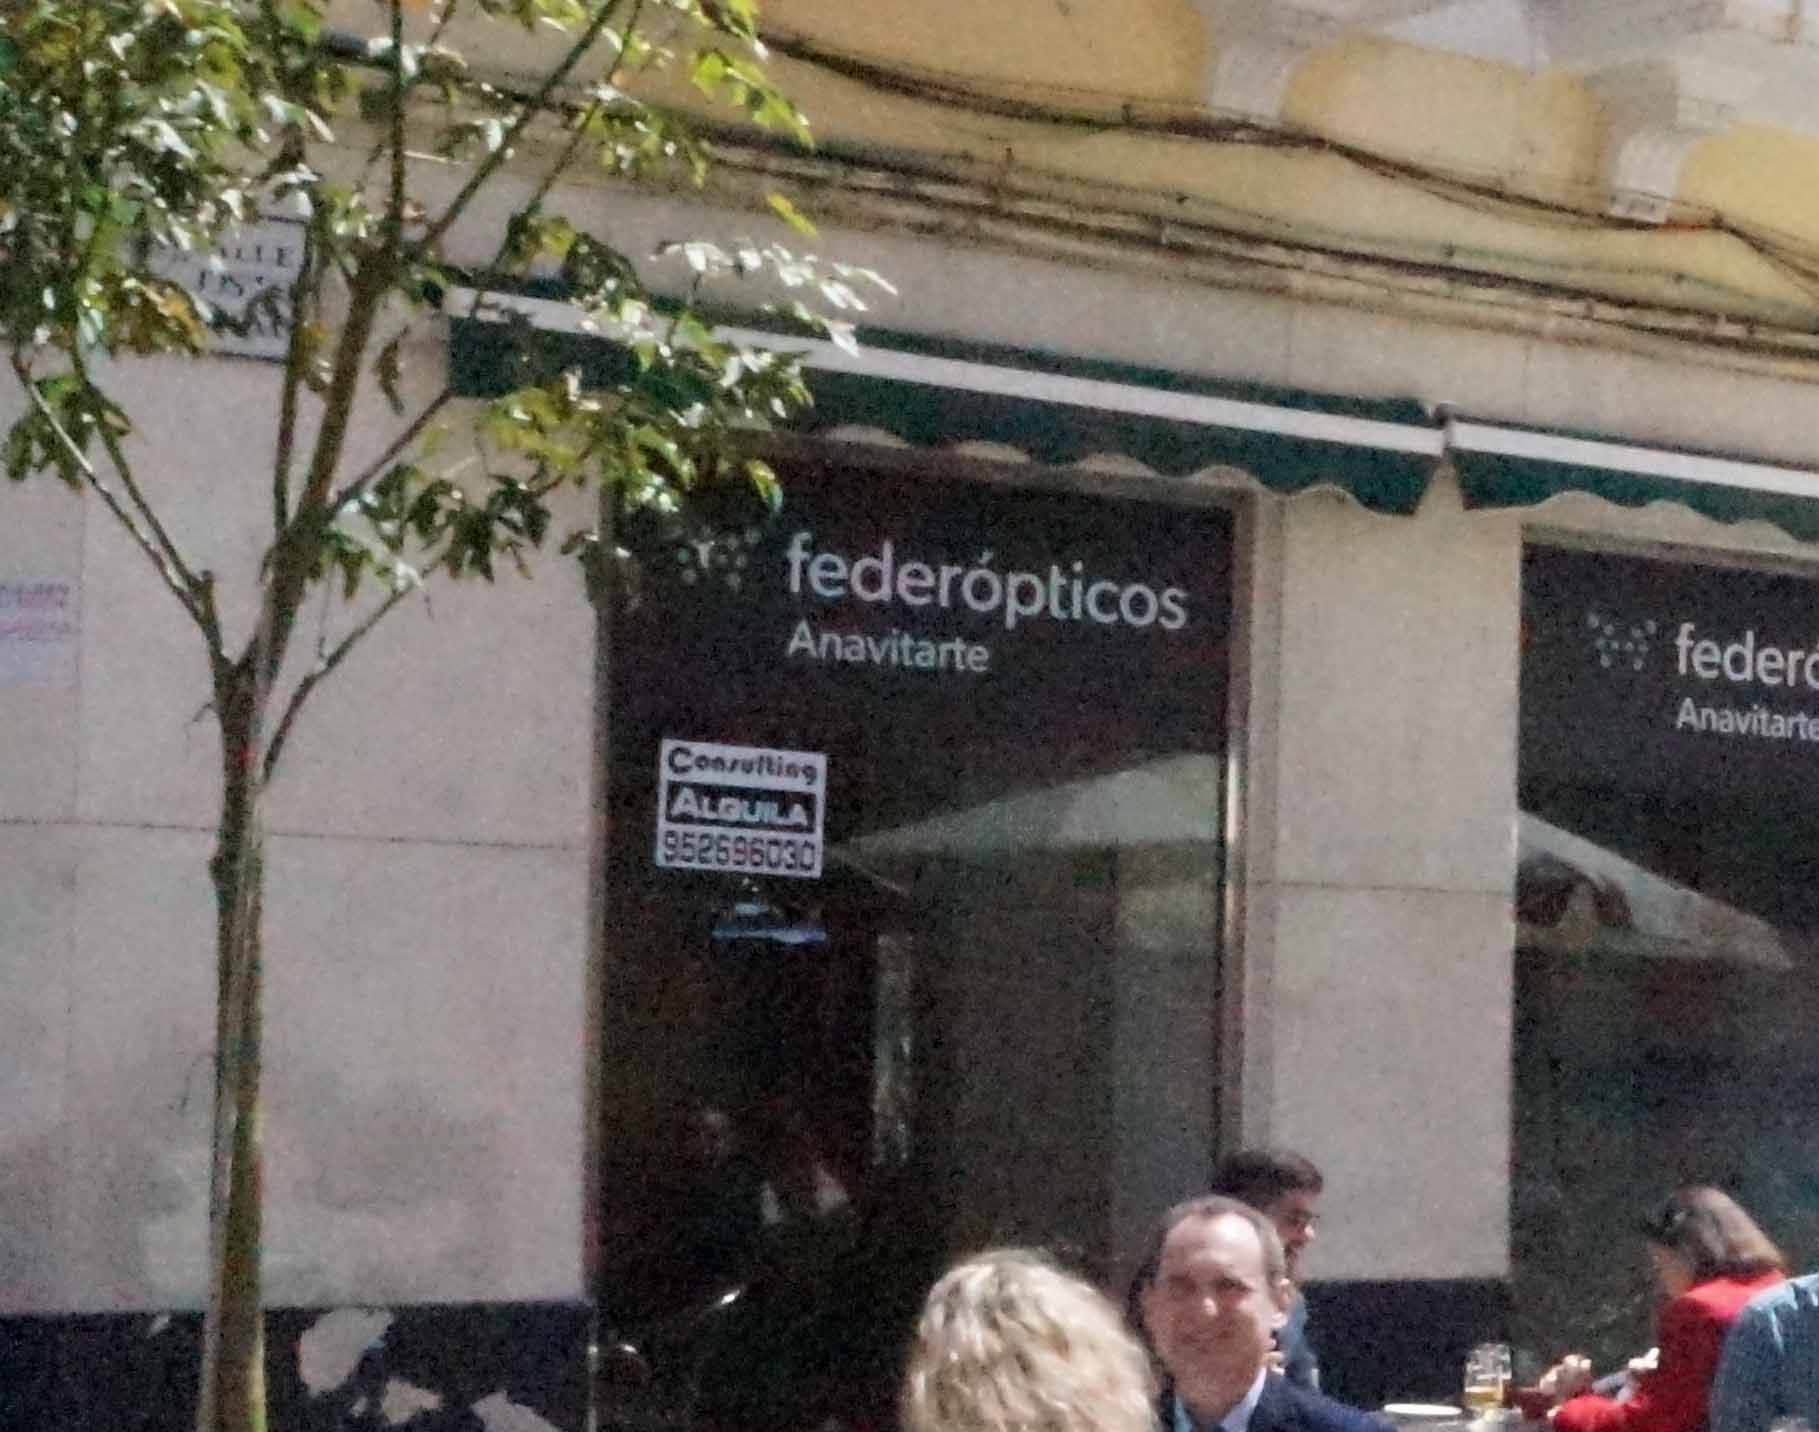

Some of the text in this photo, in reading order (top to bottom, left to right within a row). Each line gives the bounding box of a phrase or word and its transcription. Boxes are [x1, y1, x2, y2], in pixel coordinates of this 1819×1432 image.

[785, 532, 1189, 630] federópticos
[787, 620, 990, 673] Anavitarte
[668, 746, 818, 786] Consulting
[669, 786, 809, 827] ALQUILA
[663, 830, 816, 872] 952696030
